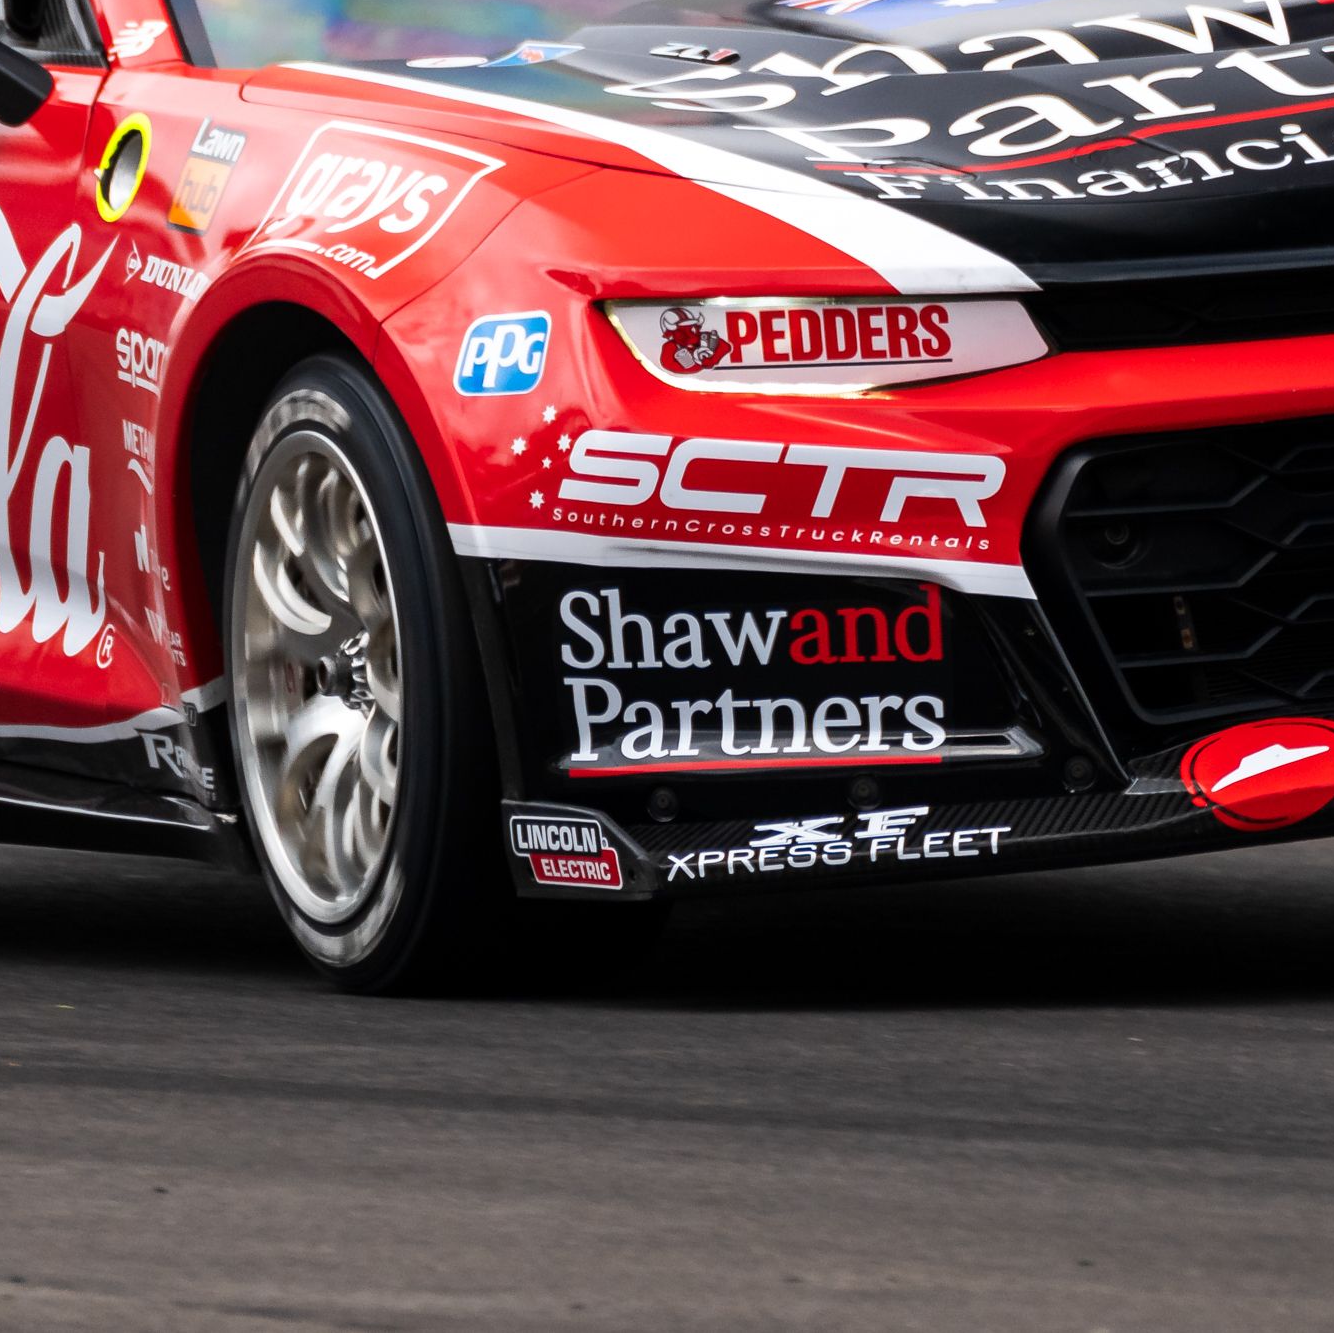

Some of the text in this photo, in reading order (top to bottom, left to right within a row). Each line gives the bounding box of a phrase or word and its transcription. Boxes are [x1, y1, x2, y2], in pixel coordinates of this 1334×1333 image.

[191, 116, 247, 163] Lawn
[174, 176, 220, 217] hub
[265, 151, 449, 235] grays
[461, 322, 547, 388] PPG
[723, 303, 953, 364] PEDDERS
[556, 428, 1008, 529] SCTR
[562, 677, 947, 763] Partners
[516, 823, 599, 854] LINCOLN
[666, 826, 1013, 882] XPRESS FLEET
[540, 858, 612, 882] ELECTRIC
